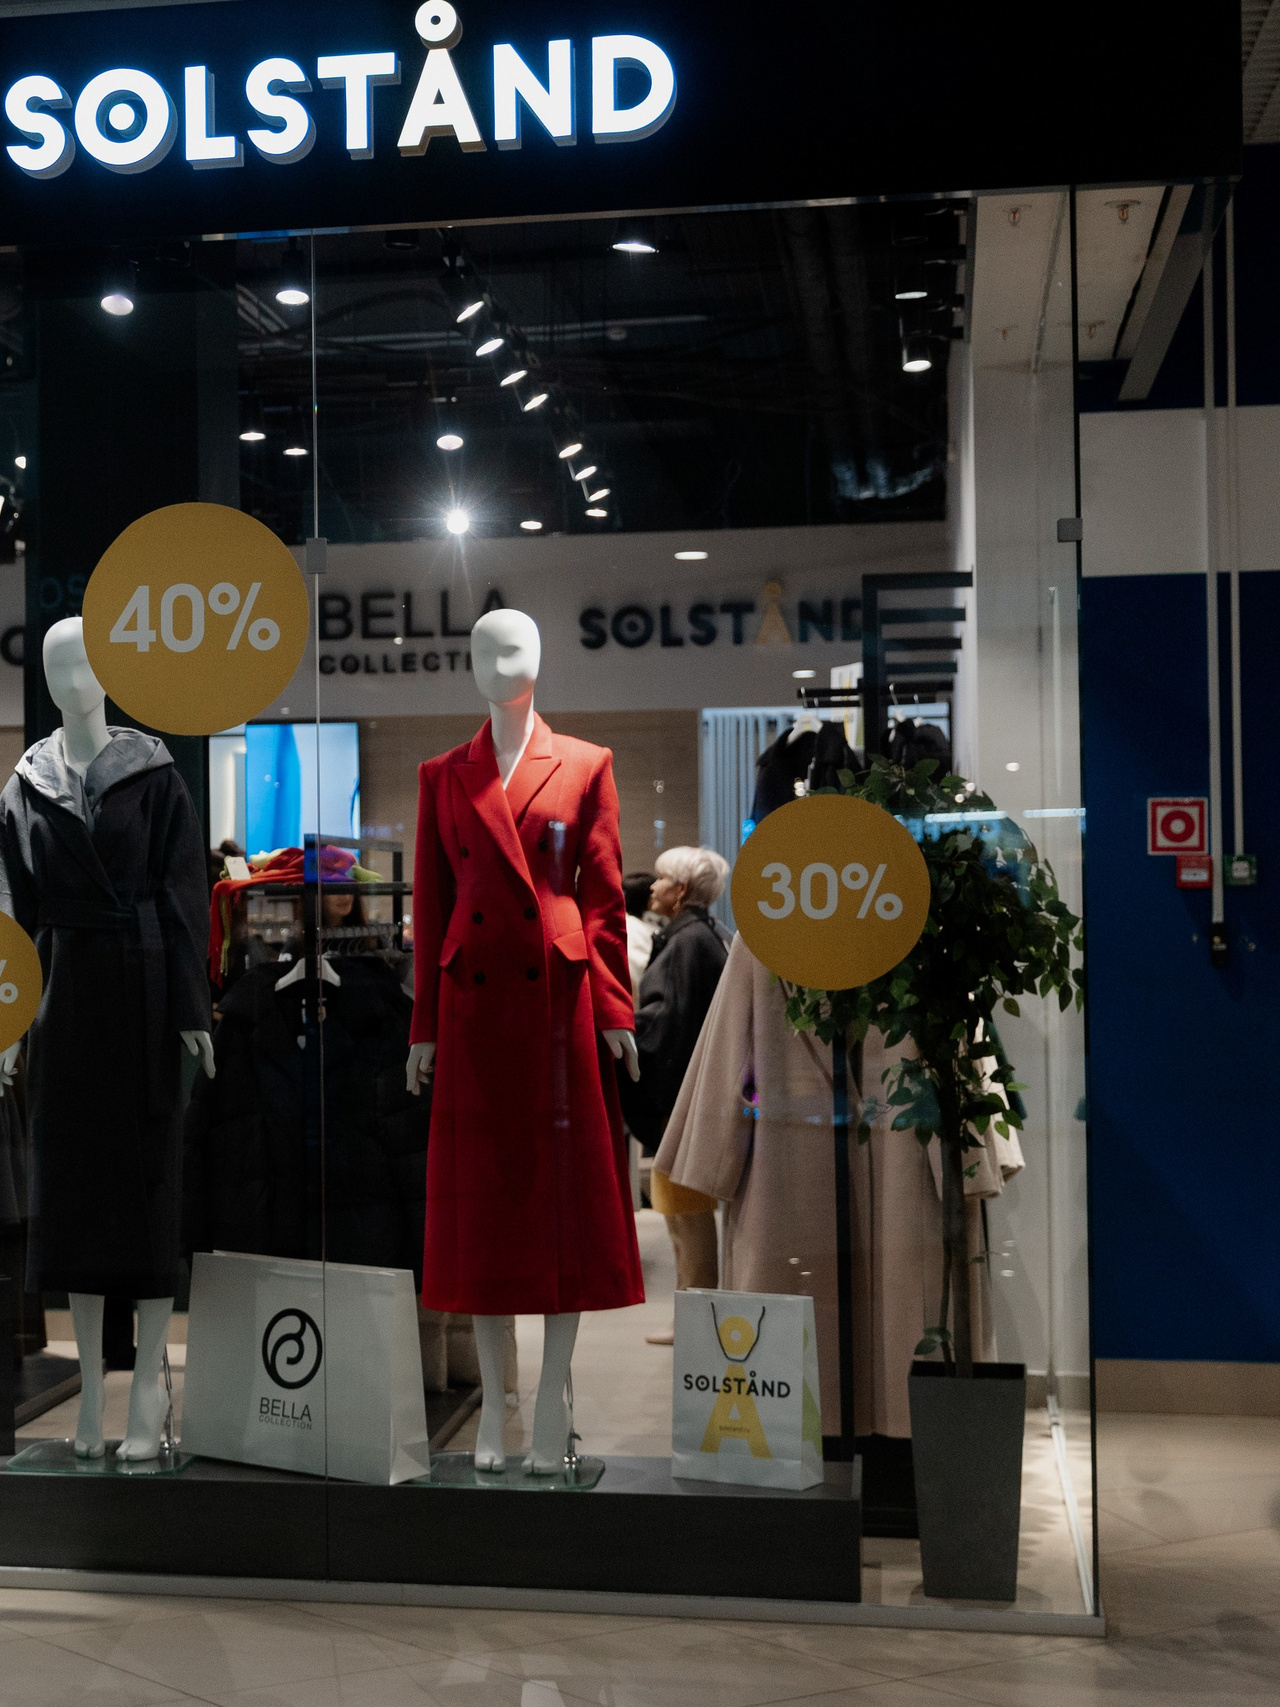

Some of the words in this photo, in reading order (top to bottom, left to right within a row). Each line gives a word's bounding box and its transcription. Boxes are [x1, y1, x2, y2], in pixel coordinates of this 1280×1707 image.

[5, 0, 676, 172] SOLSTÅND
[109, 582, 281, 653] 40%
[319, 651, 473, 675] COLLECTI
[757, 862, 904, 921] 30%
[683, 1370, 791, 1398] SOLSTÅND
[258, 1415, 312, 1431] COLLECTION
[259, 1397, 312, 1422] BELLA
